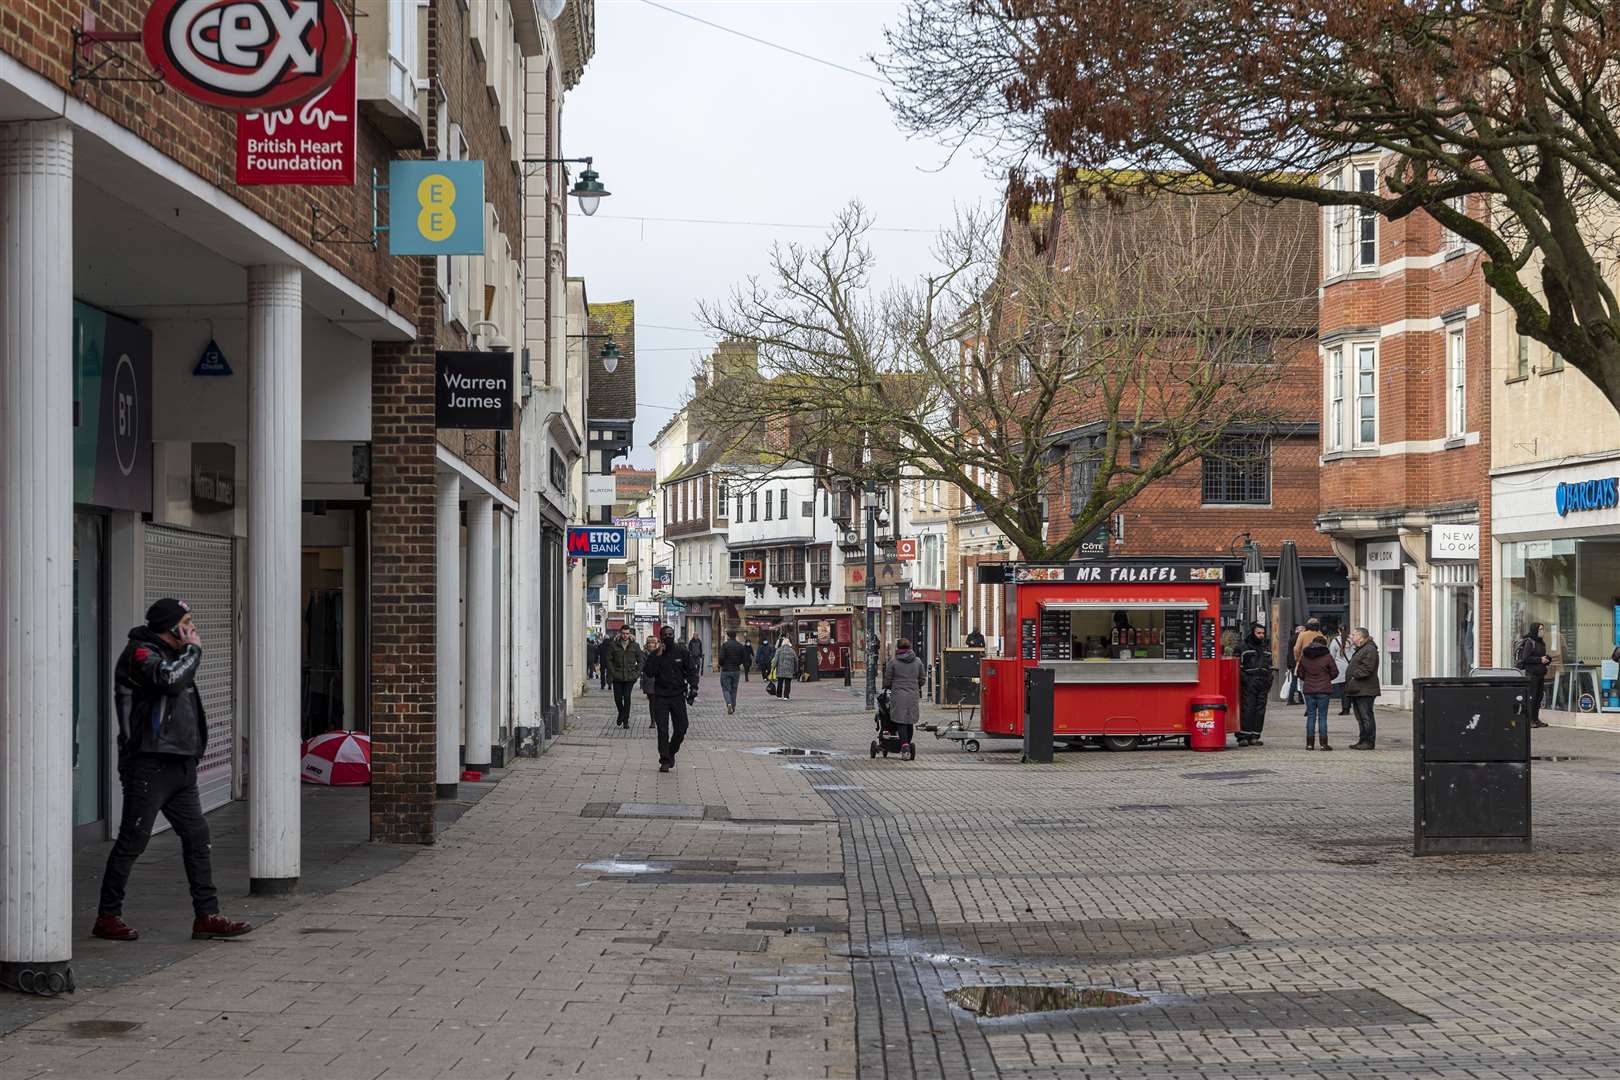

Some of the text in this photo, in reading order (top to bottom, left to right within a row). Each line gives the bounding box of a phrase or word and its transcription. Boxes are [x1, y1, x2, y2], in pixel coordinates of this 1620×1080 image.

[247, 138, 343, 153] British Heart
[247, 156, 343, 170] Foundation
[444, 373, 507, 390] Warren
[448, 393, 502, 409] James
[119, 392, 133, 437] BT
[1567, 478, 1617, 509] BARCLAYS
[568, 531, 621, 553] METRO
[1442, 532, 1474, 541] NEW
[591, 544, 621, 553] BANK
[1439, 543, 1476, 551] LOOK
[1368, 551, 1393, 561] NEW LOOK
[1076, 566, 1177, 582] MR FALAFEL
